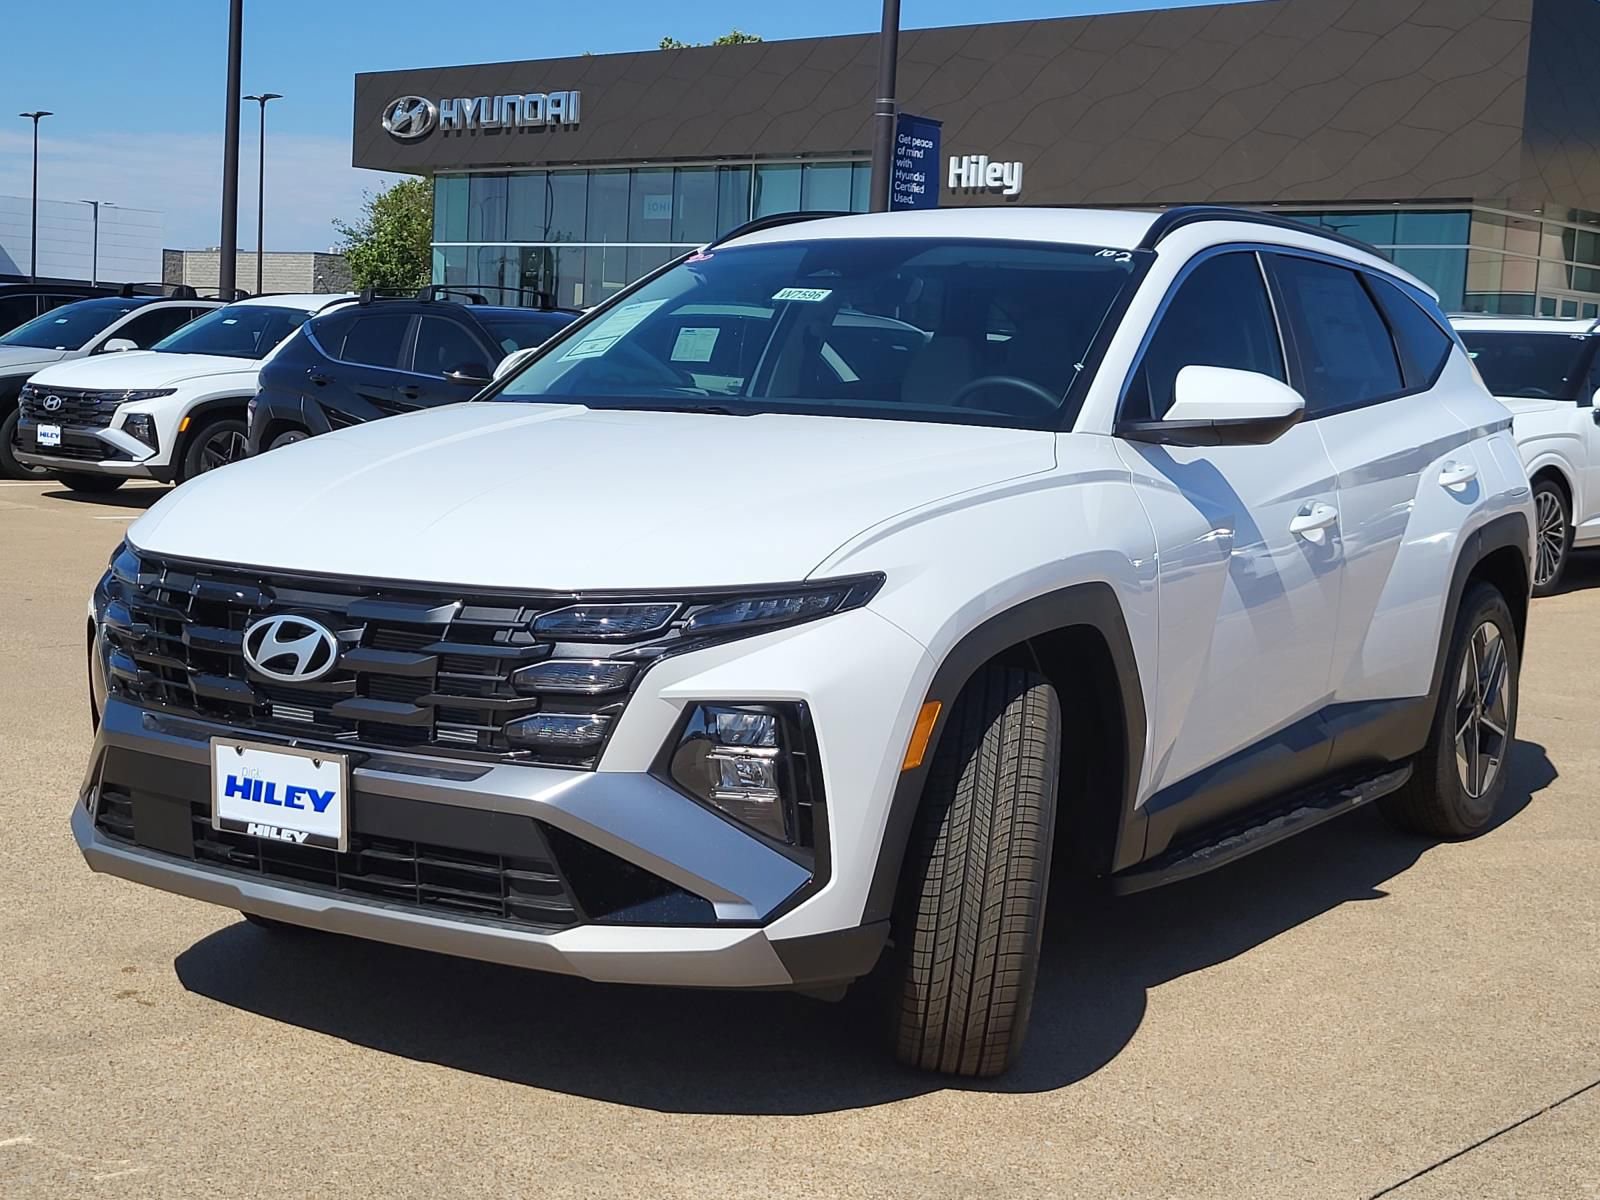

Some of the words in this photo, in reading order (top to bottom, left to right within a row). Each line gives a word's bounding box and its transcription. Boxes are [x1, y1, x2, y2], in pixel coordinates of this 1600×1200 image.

[439, 91, 582, 131] HYUNDAI
[898, 134, 911, 144] Get
[912, 138, 933, 148] peace
[897, 146, 906, 155] of
[906, 147, 924, 158] mind
[896, 158, 913, 168] with
[895, 170, 925, 181] Hyundai
[948, 155, 1023, 195] Hiley
[894, 182, 925, 193] Certified
[894, 193, 914, 204] Used.
[224, 775, 336, 812] HILEY
[247, 823, 309, 843] HILEY
